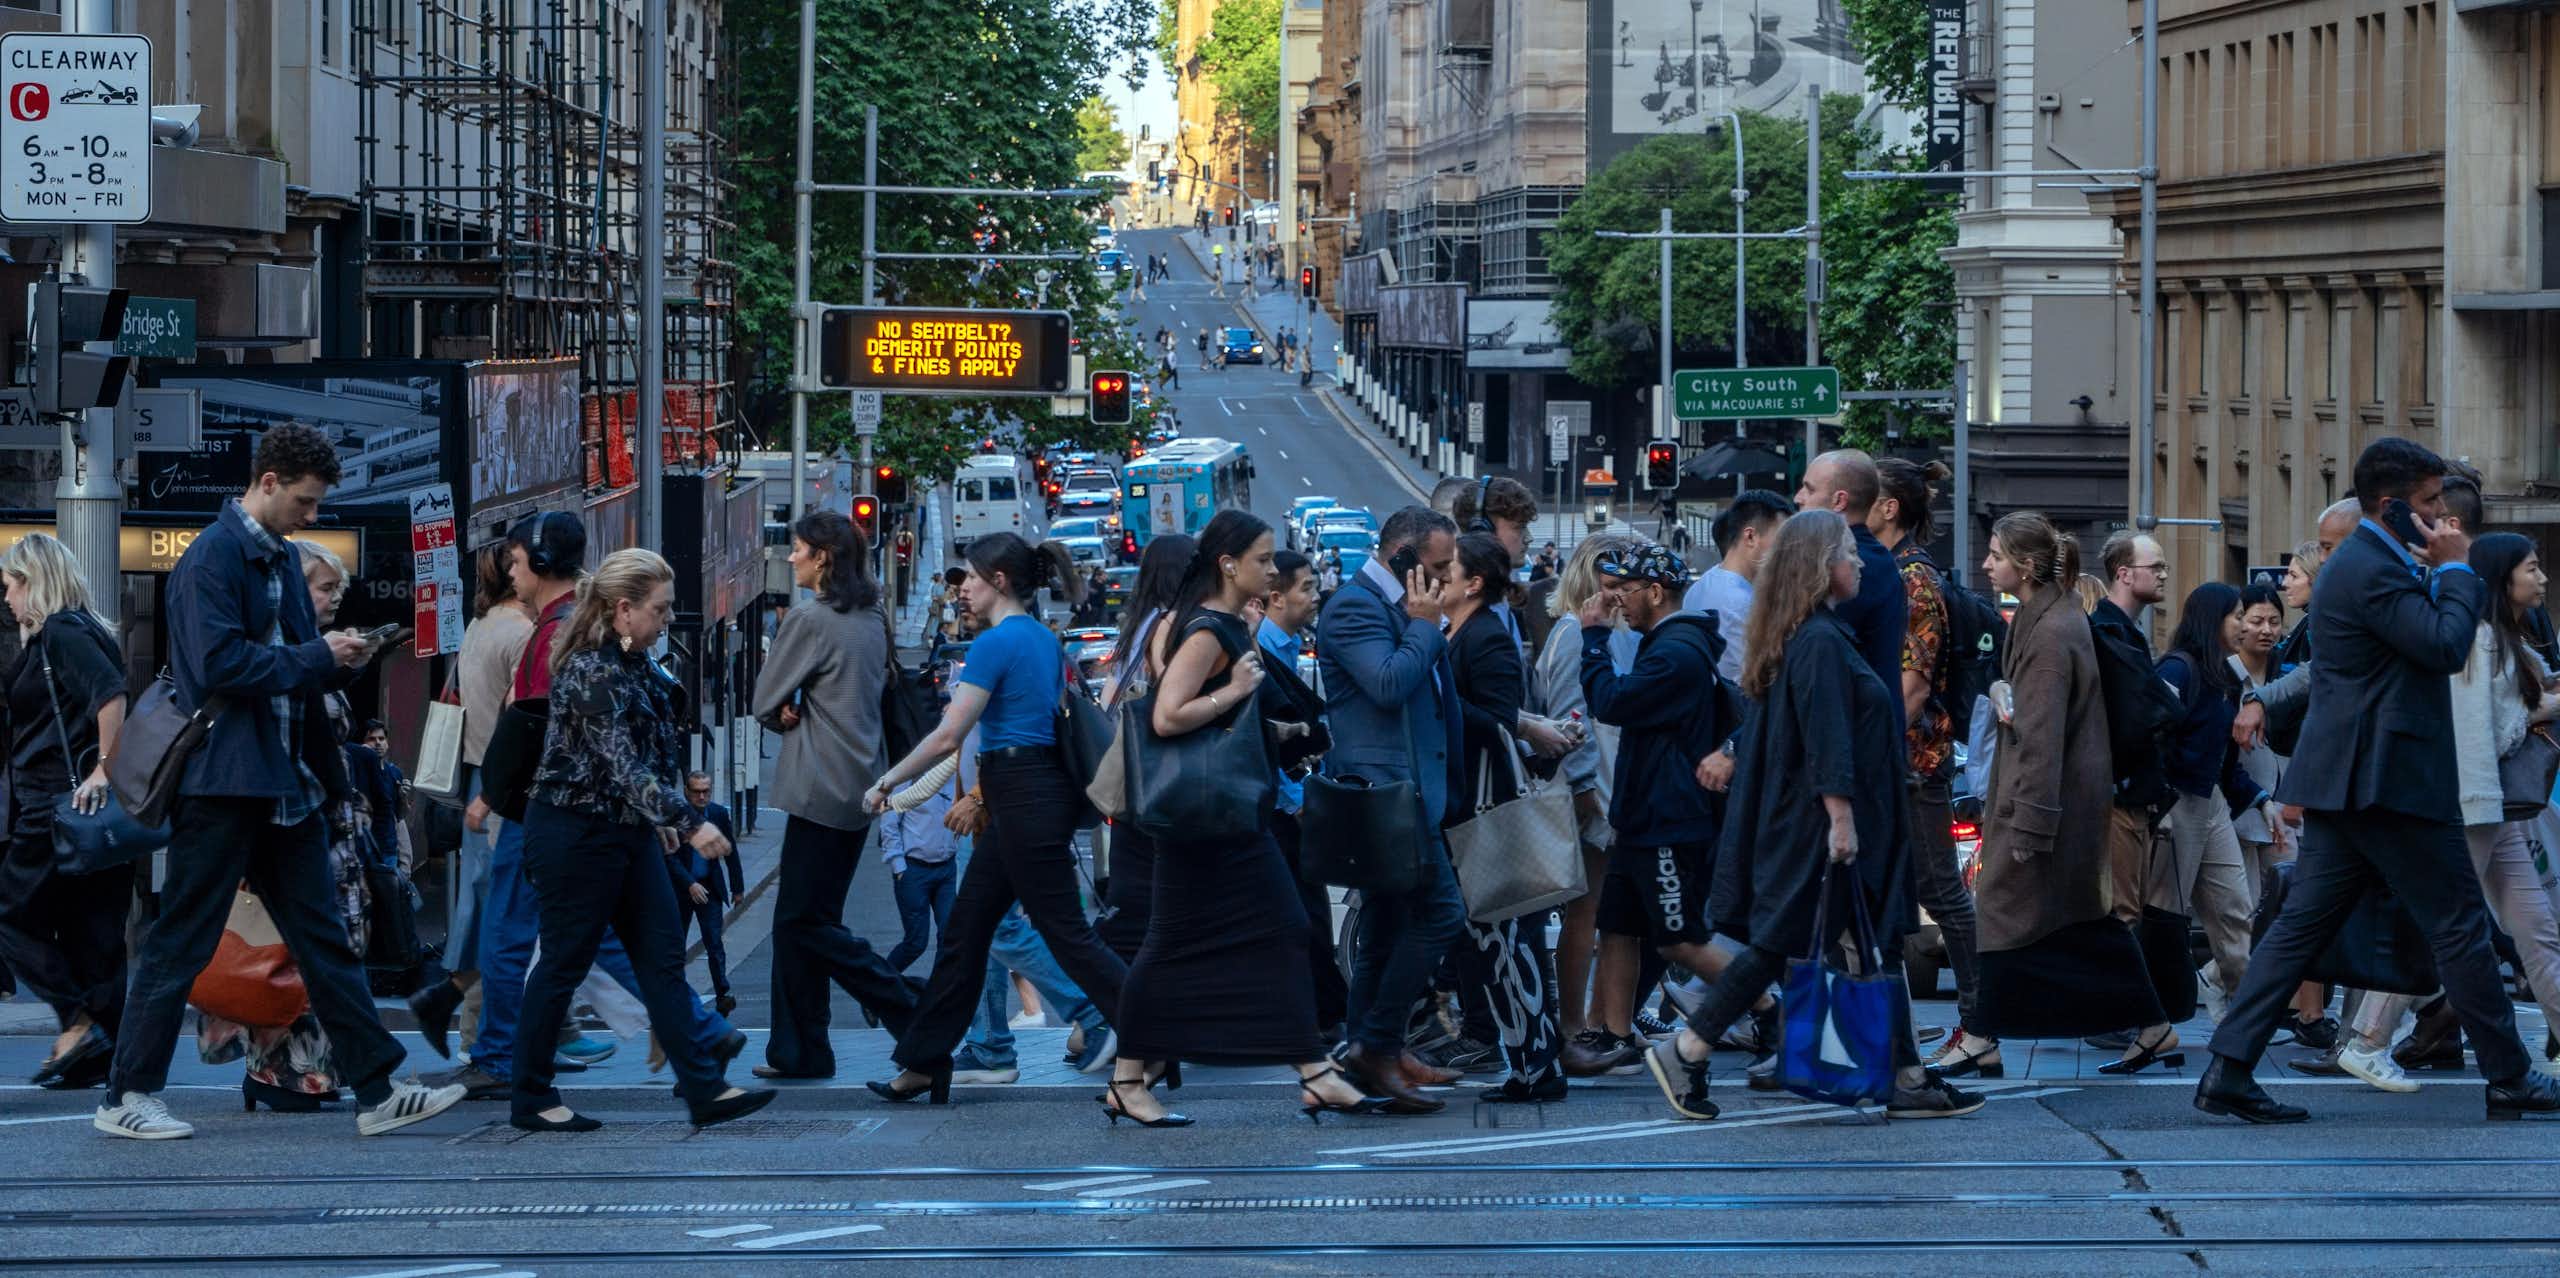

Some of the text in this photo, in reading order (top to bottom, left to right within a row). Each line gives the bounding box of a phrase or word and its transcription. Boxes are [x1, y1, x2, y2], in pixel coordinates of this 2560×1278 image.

[1935, 8, 1961, 19] THE
[12, 50, 138, 70] CLEARWAY
[1932, 21, 1961, 145] REPUBLIC
[18, 84, 41, 119] C
[27, 191, 66, 205] MON
[95, 192, 123, 206] FRI
[123, 307, 180, 344] Bridge St
[878, 321, 1012, 341] NO SEATBELT?
[866, 339, 1022, 359] DEMERIT POINTS
[872, 357, 1017, 377] & FINES APPLY
[1691, 377, 1797, 395] City South
[859, 394, 875, 404] NO
[1684, 397, 1806, 411] VIA MACQUARIE ST
[415, 524, 424, 533] NO
[151, 530, 200, 557] BIS
[417, 553, 432, 563] TAXI
[422, 588, 432, 600] NO
[1656, 847, 1684, 931] adidas
